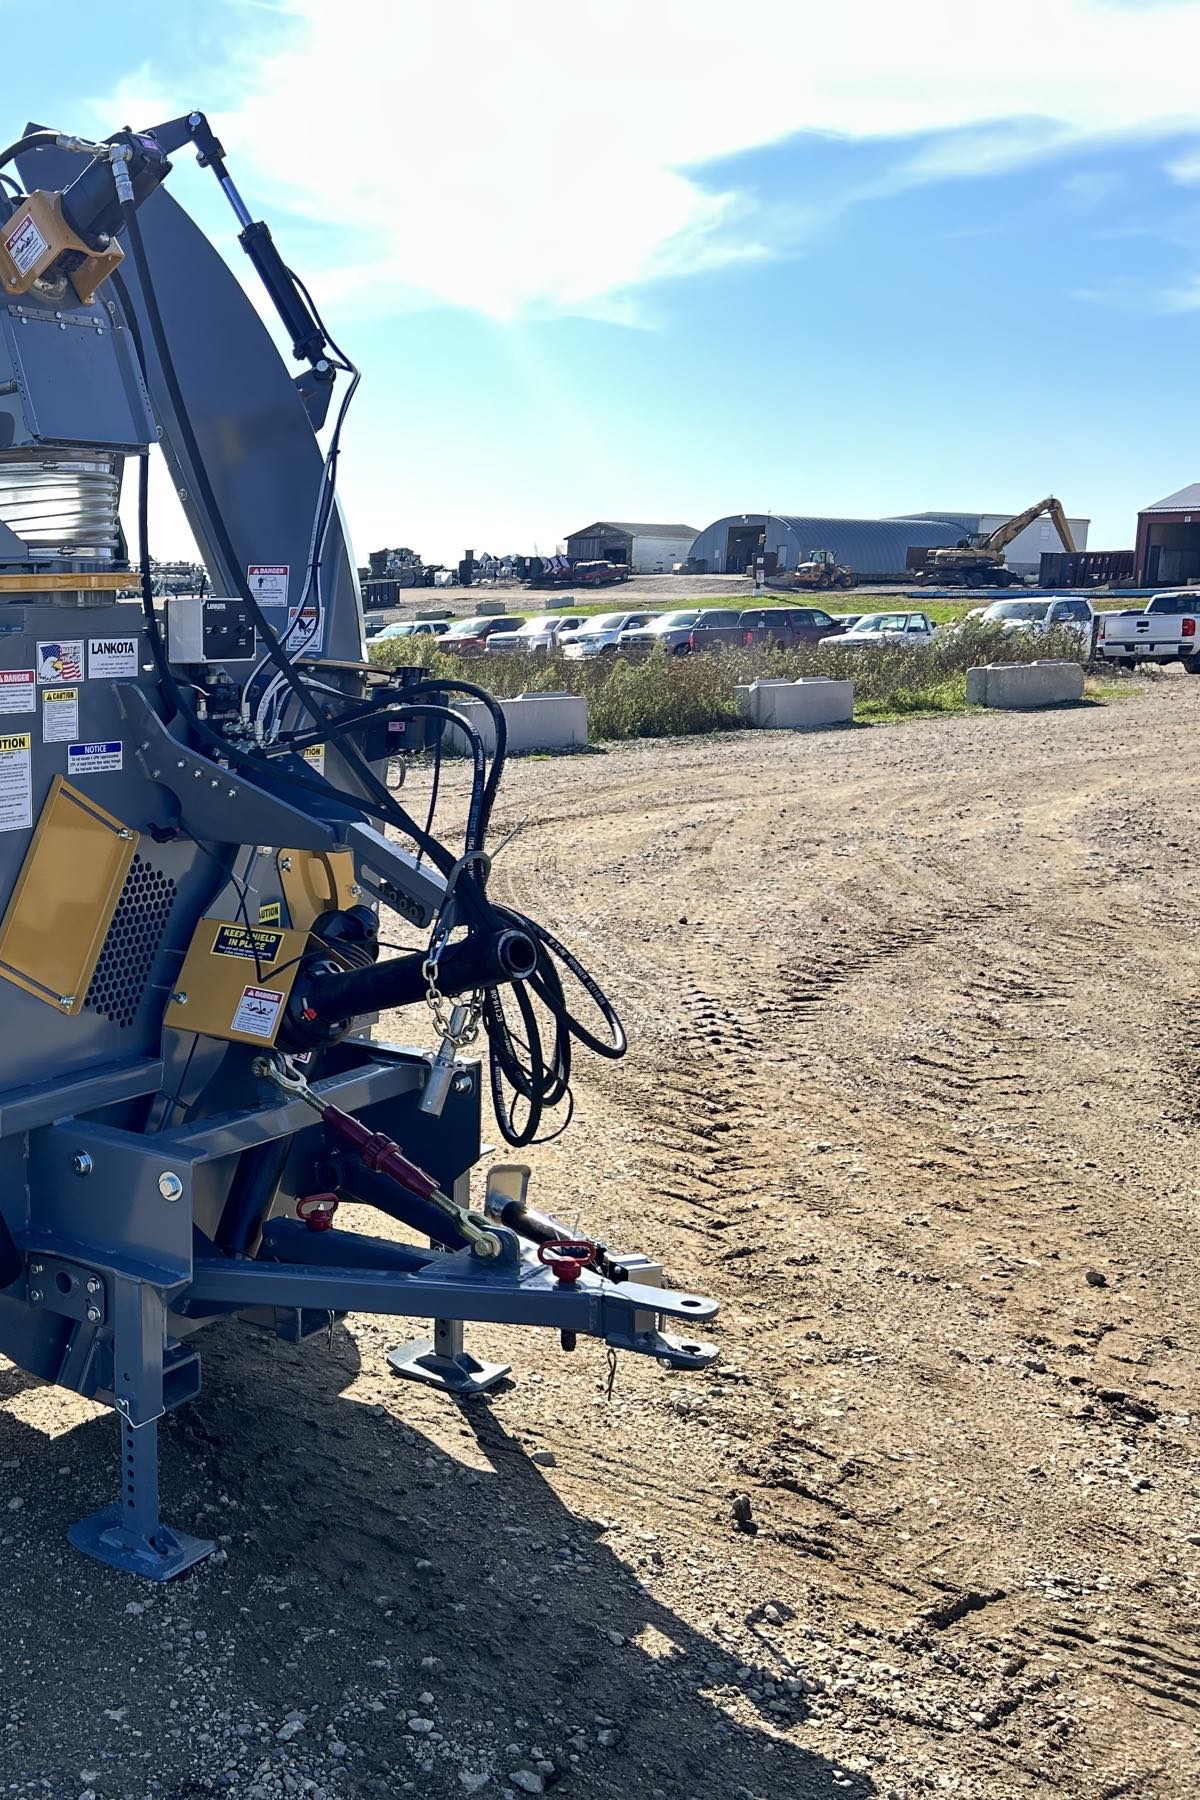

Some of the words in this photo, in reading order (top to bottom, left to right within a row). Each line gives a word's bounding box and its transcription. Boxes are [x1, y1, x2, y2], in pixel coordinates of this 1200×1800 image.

[91, 642, 135, 654] LANKOTA
[3, 673, 30, 682] DANGER
[52, 692, 74, 700] CAUTION
[84, 744, 107, 754] NOTICE
[304, 747, 321, 756] TION
[259, 906, 279, 919] UTION
[223, 928, 246, 939] KEEP
[228, 938, 238, 946] IN
[567, 957, 589, 981] WINNER
[254, 989, 279, 1001] DANGER
[490, 989, 504, 1022] EC118-08
